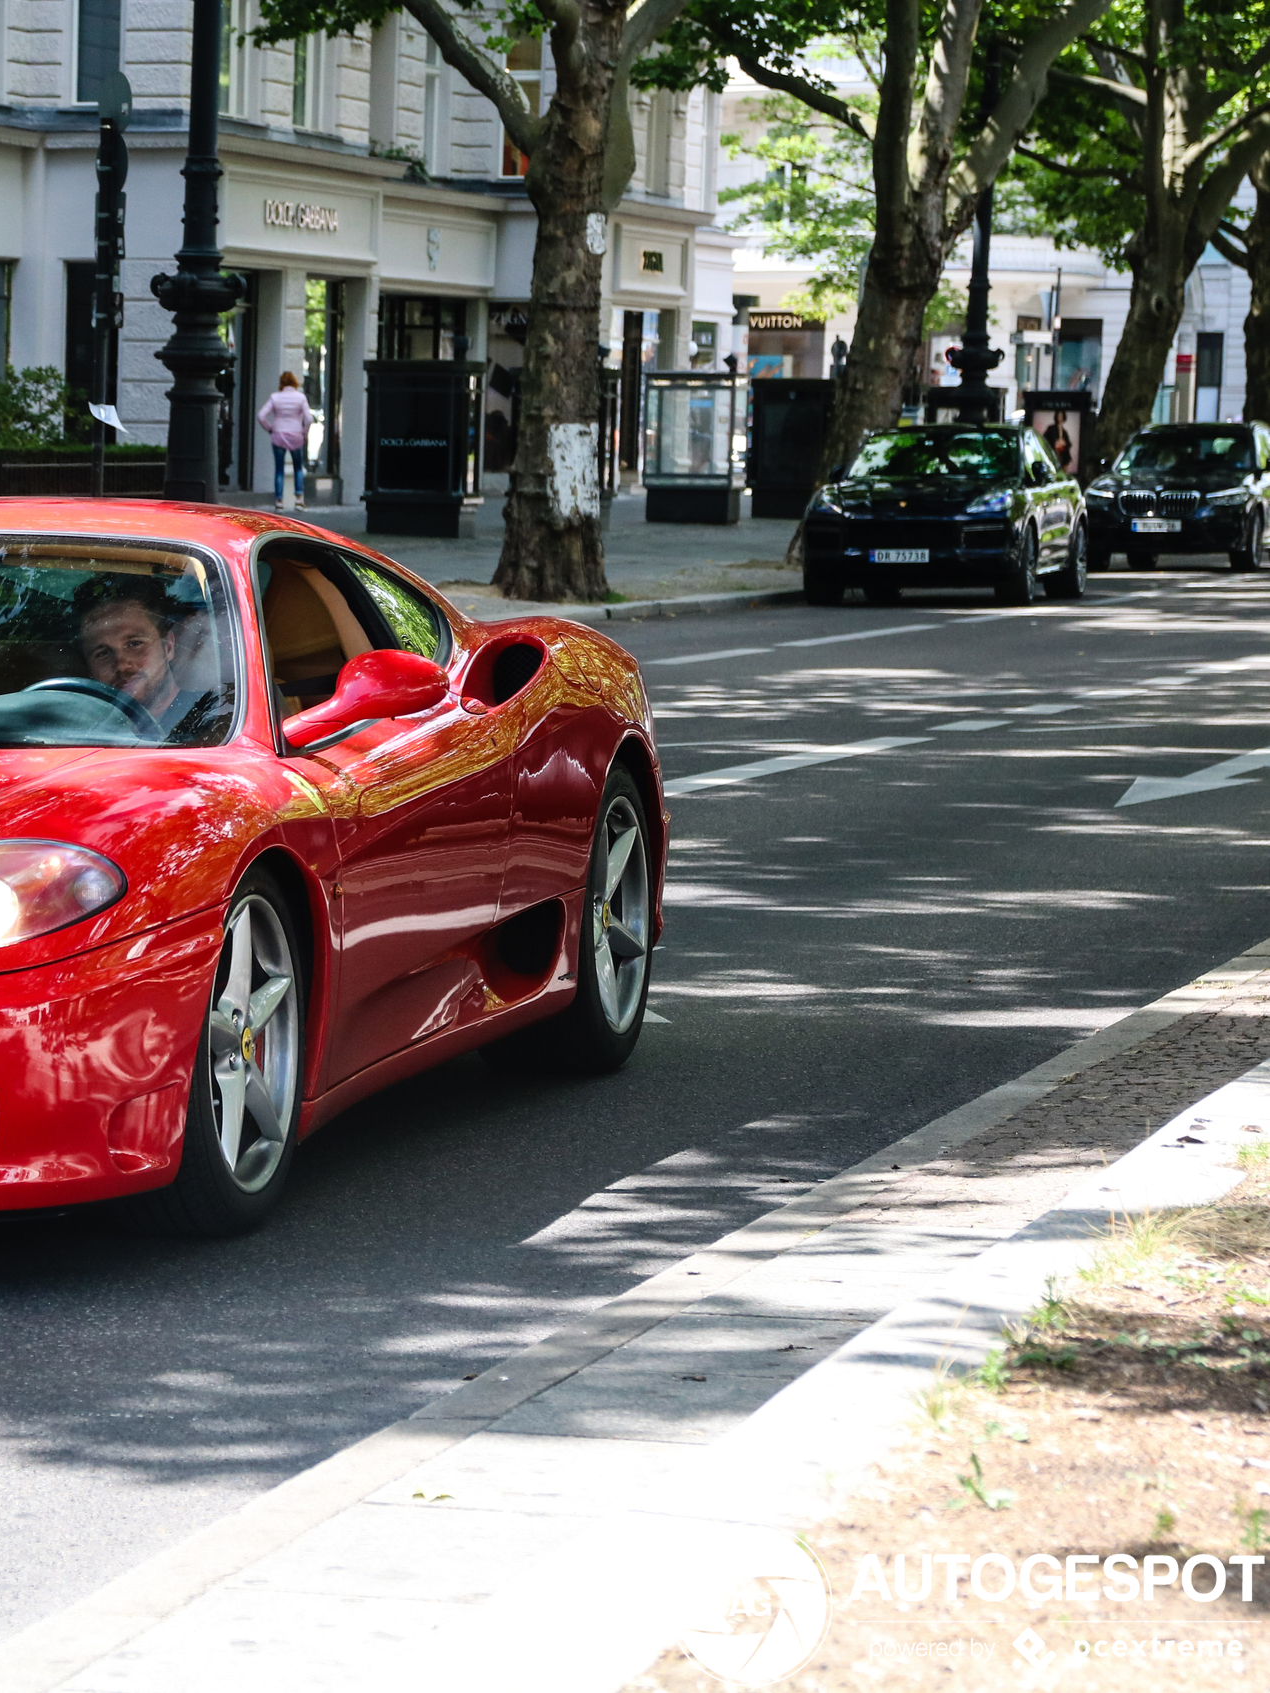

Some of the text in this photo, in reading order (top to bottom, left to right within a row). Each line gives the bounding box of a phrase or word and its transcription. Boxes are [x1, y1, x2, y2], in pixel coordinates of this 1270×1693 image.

[266, 200, 293, 226] DOLCE
[298, 204, 338, 231] GABBANA
[750, 314, 802, 329] VUITTON
[877, 552, 891, 561] DR
